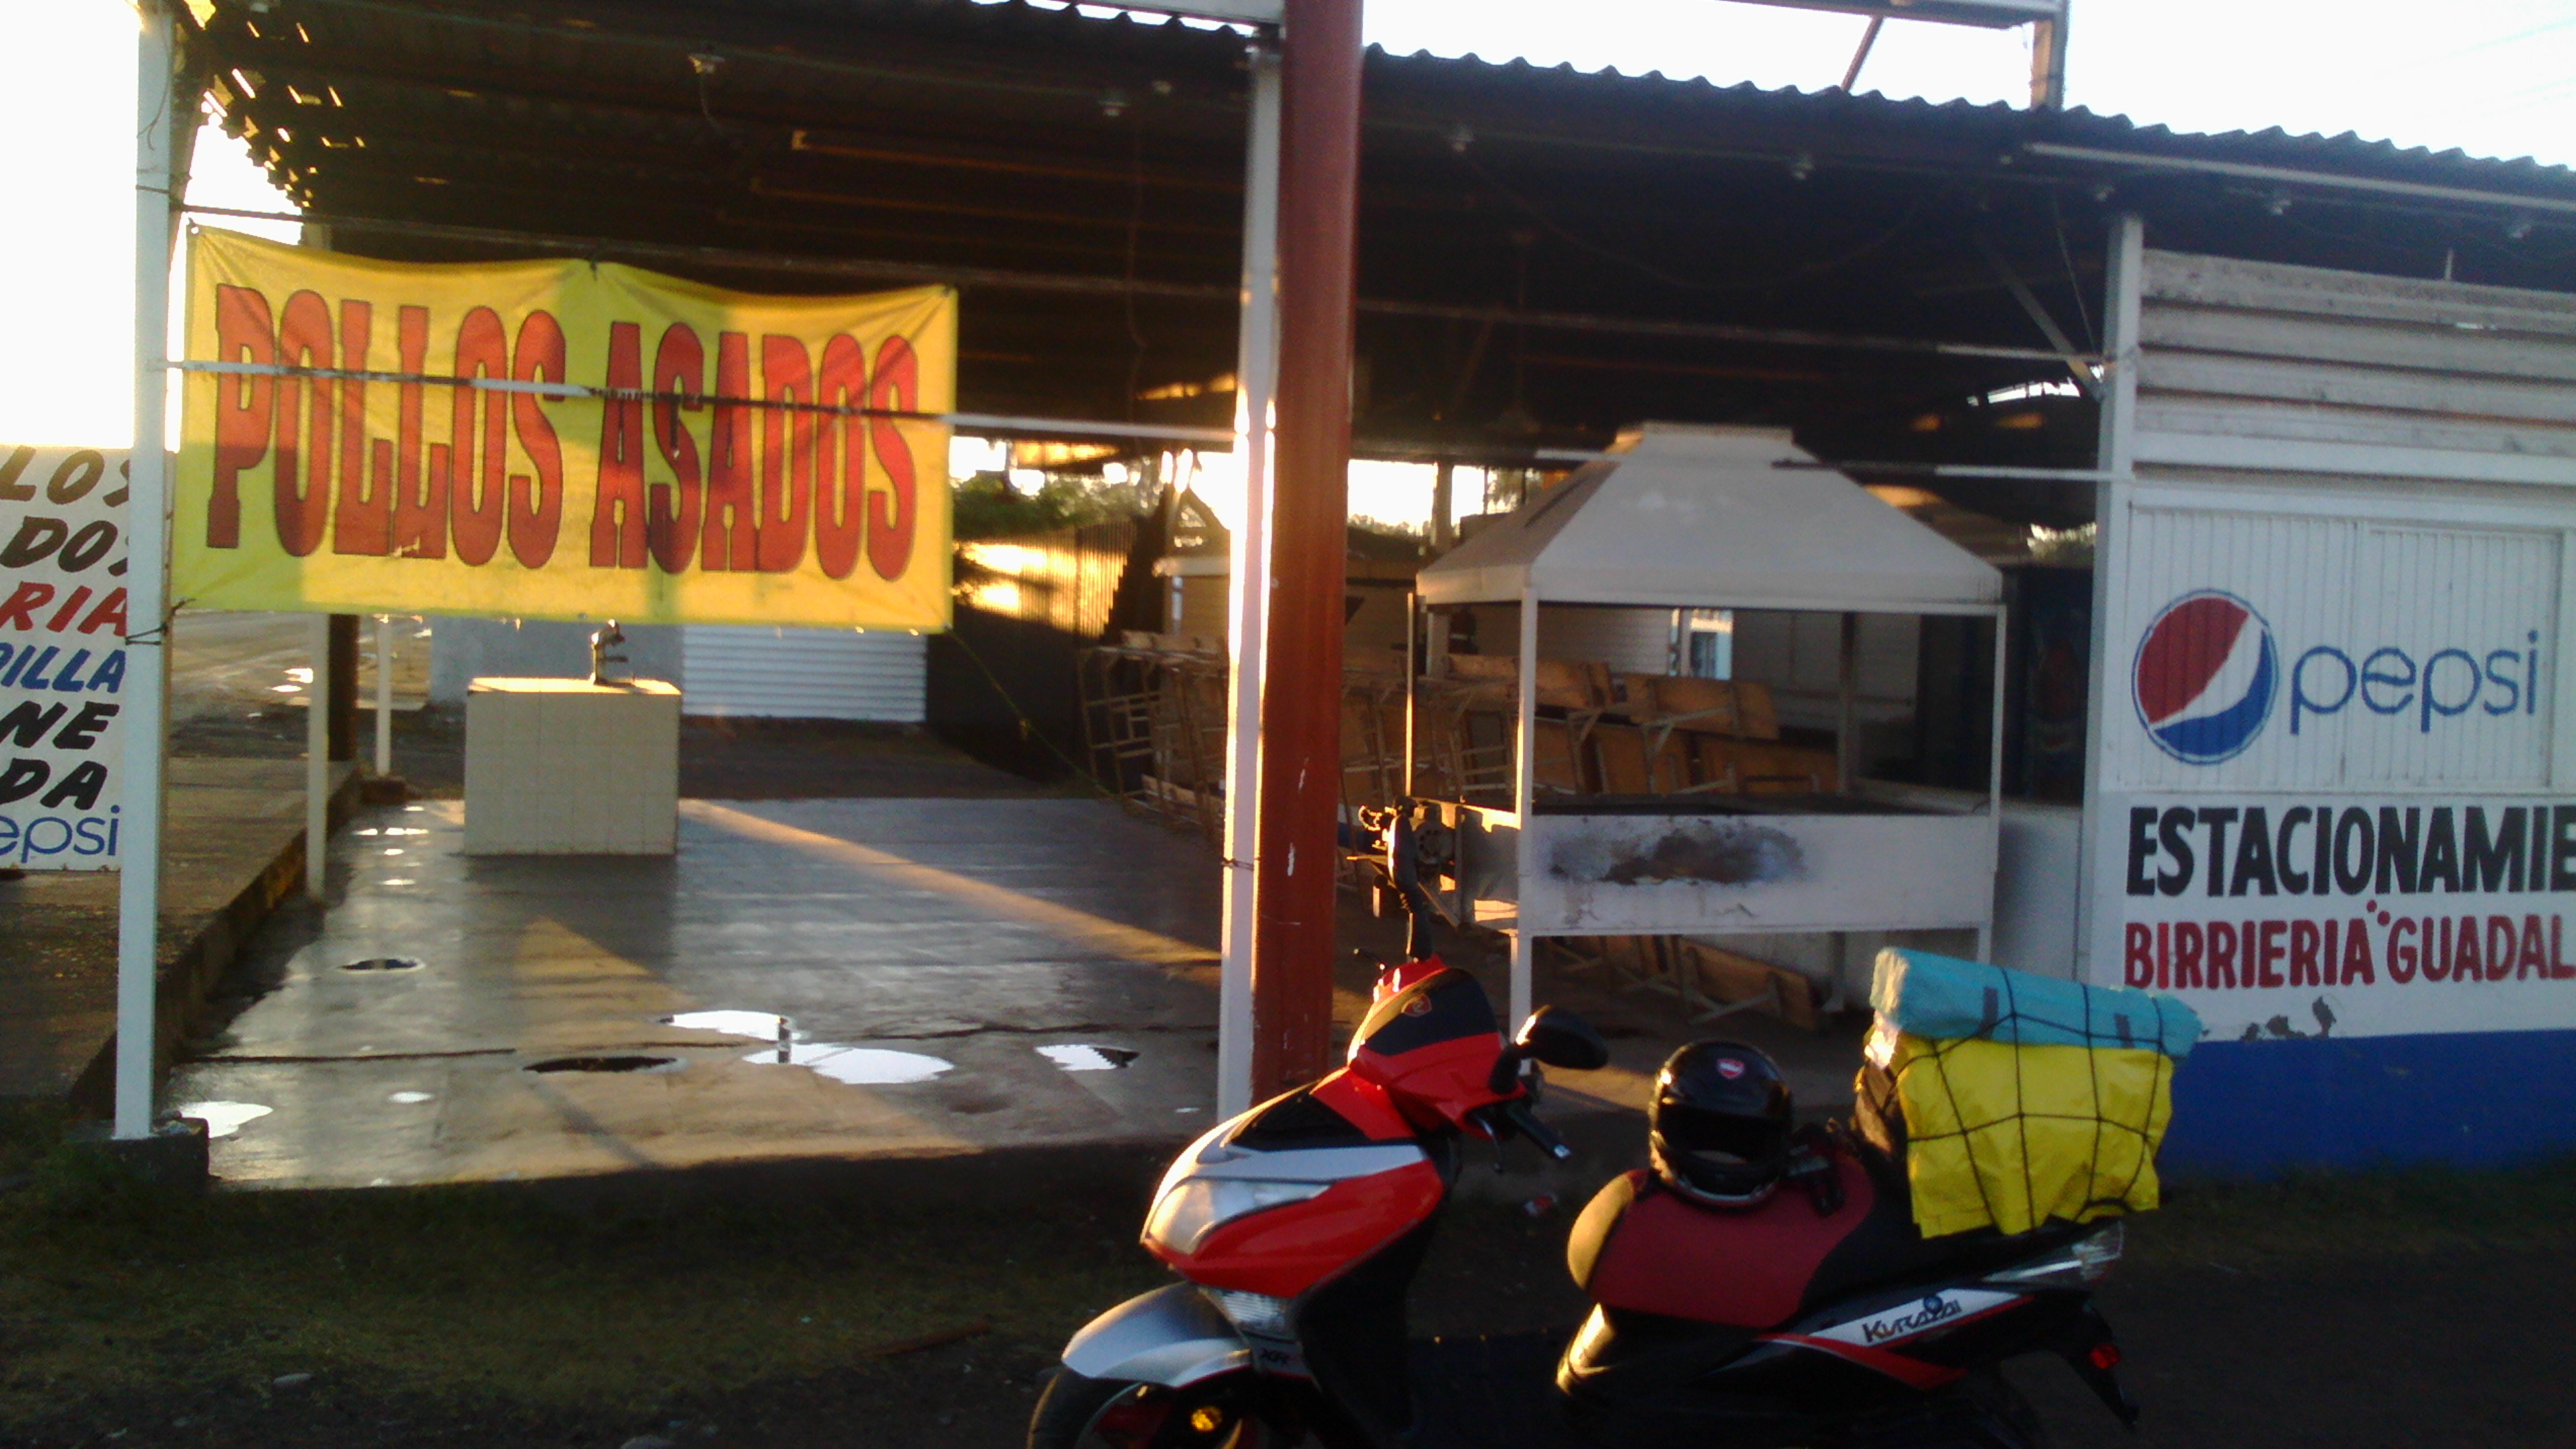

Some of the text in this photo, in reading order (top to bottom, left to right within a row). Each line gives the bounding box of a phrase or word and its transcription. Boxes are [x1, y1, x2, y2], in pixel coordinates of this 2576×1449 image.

[207, 283, 918, 582] POLLOS ASADOS
[0, 515, 128, 577] DO
[0, 580, 127, 637] RIA
[2289, 629, 2539, 735] pepsi
[0, 700, 120, 750] NE
[0, 757, 107, 810] DA
[2126, 806, 2576, 897] ESTACIONAMIE
[2125, 918, 2375, 989] BIRRIERIA
